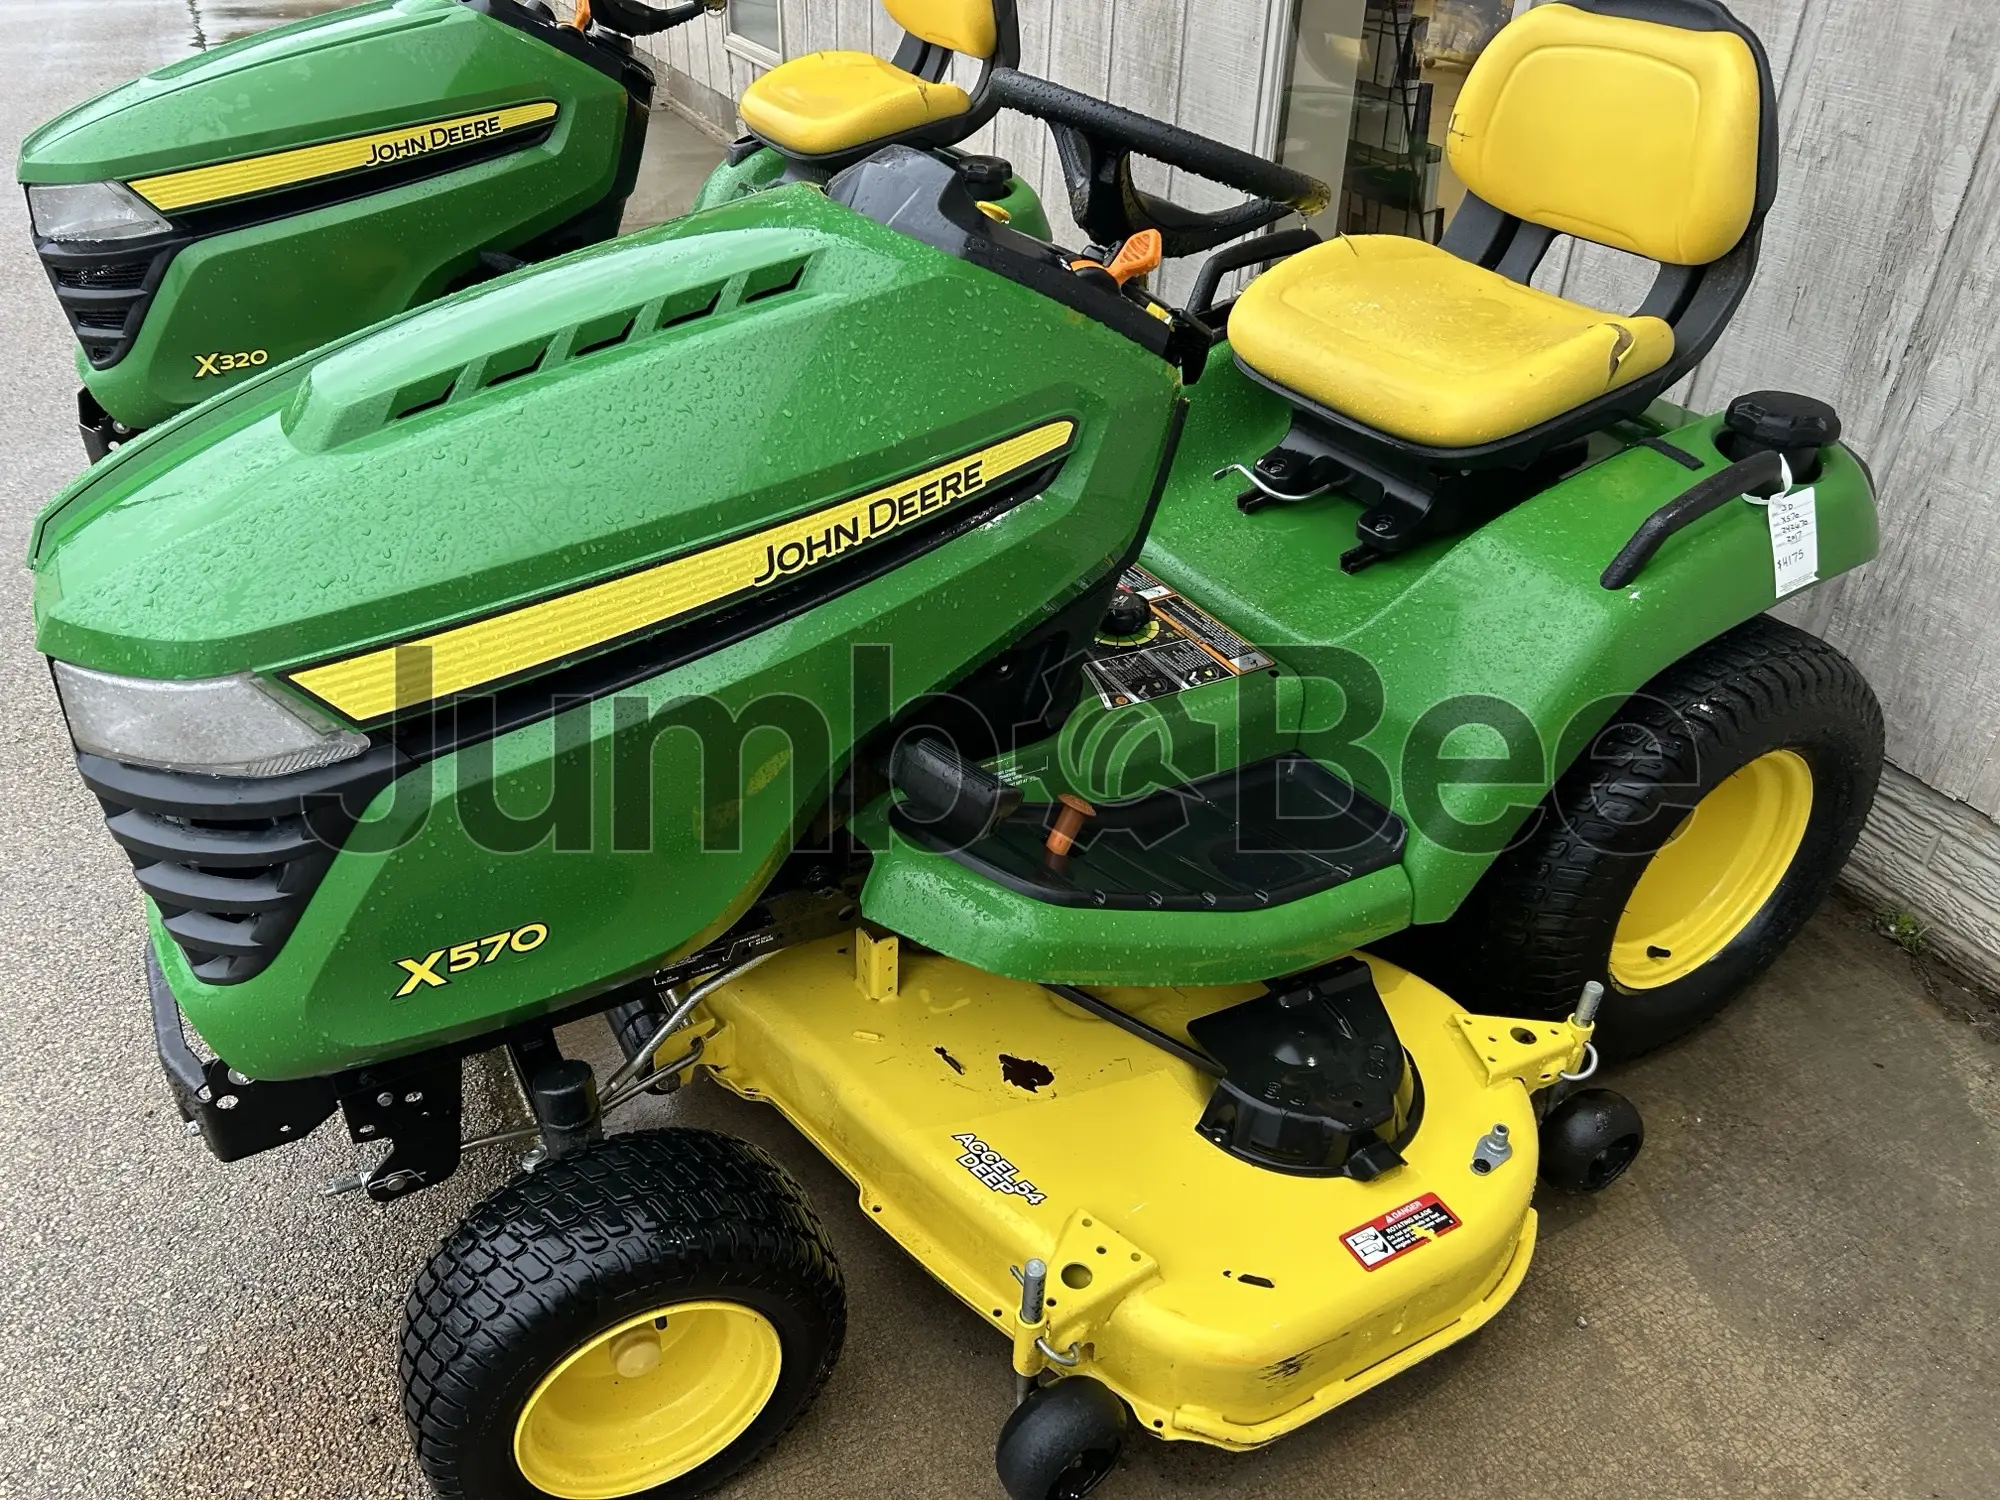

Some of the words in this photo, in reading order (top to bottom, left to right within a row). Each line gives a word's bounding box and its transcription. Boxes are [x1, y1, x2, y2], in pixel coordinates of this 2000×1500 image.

[365, 135, 427, 166] JOHN
[430, 116, 502, 149] DEERE
[192, 348, 269, 379] X320
[754, 516, 860, 585] JOHN
[869, 460, 984, 536] DEERE
[1777, 549, 1804, 571] $4175
[390, 921, 549, 1000] X570
[951, 1133, 1020, 1185] ACCEL
[956, 1152, 1016, 1196] DEEP
[1014, 1180, 1047, 1205] 54
[1386, 1217, 1415, 1234] ROTATING
[1413, 1208, 1433, 1221] BLADE
[1391, 1200, 1423, 1220] DANGER
